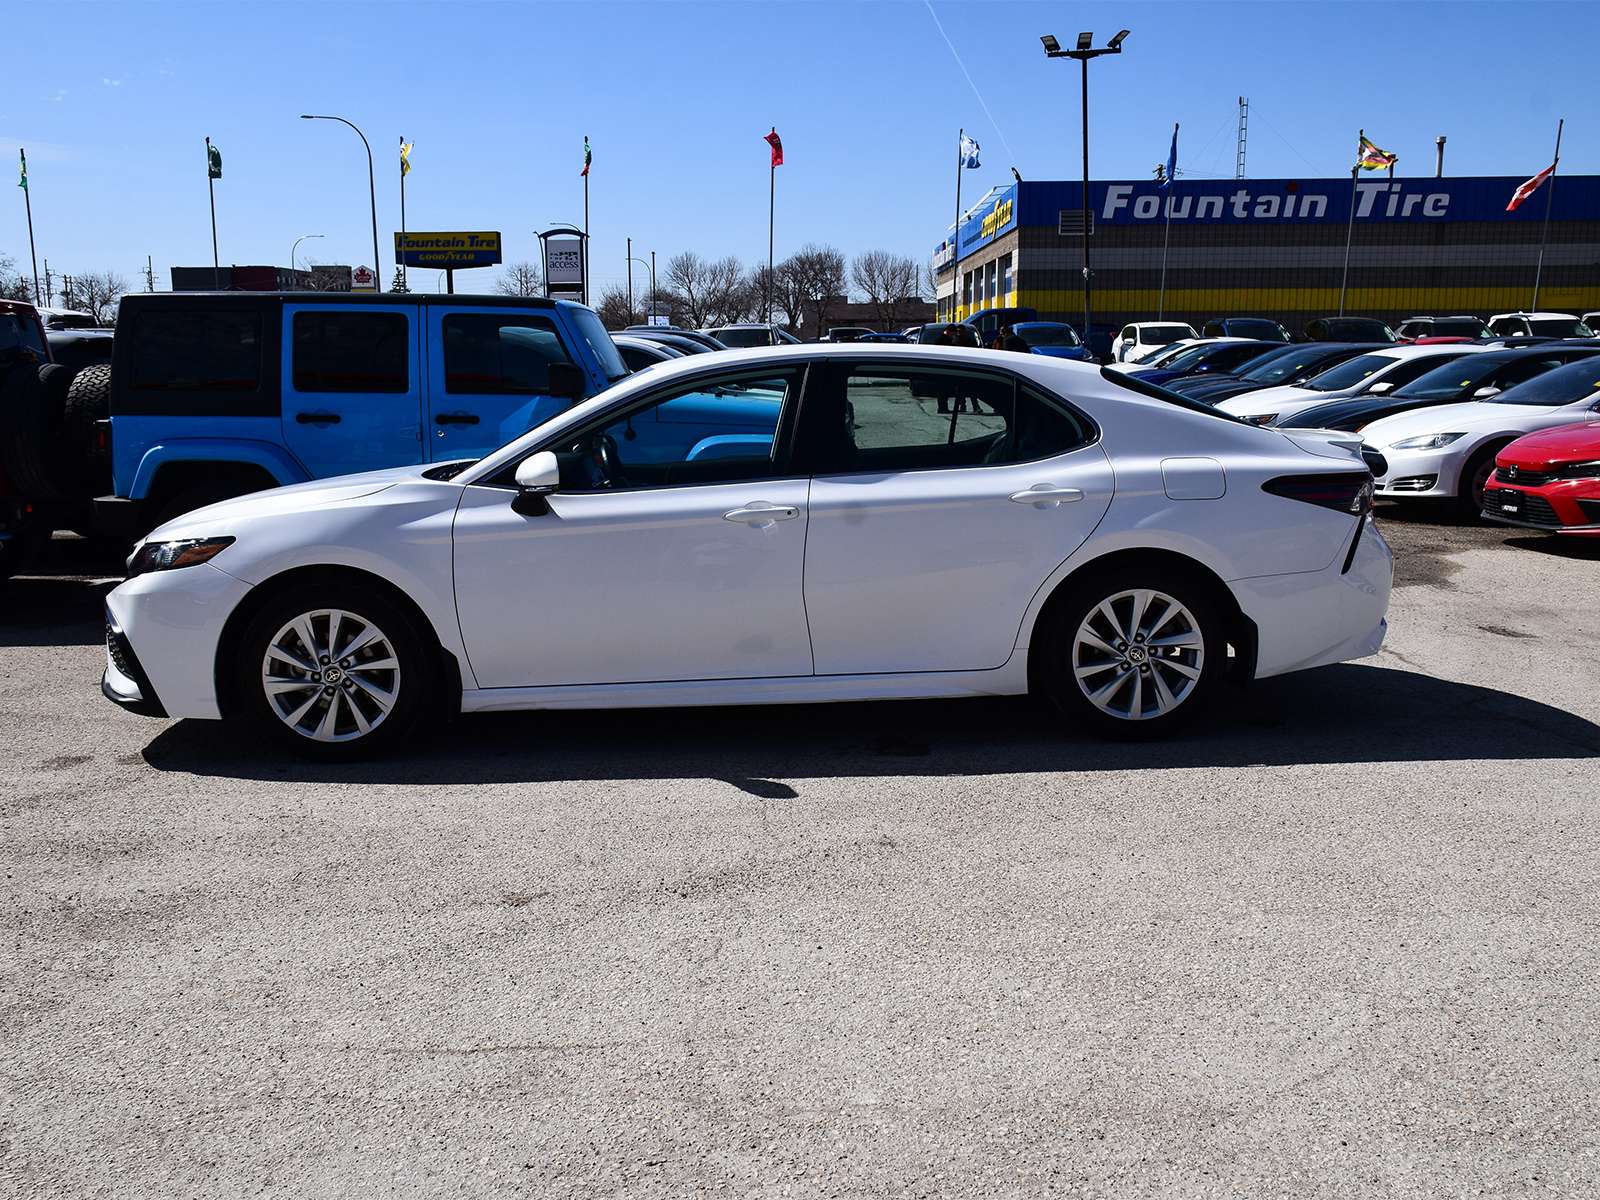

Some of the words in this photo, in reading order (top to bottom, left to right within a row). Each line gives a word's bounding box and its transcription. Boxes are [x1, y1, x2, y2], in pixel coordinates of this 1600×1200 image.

[1102, 183, 1328, 219] Fountain
[1356, 183, 1450, 217] Tire
[398, 235, 465, 248] Fountain
[467, 235, 496, 248] Tire
[418, 251, 475, 261] GOODYEAR
[549, 260, 579, 269] access
